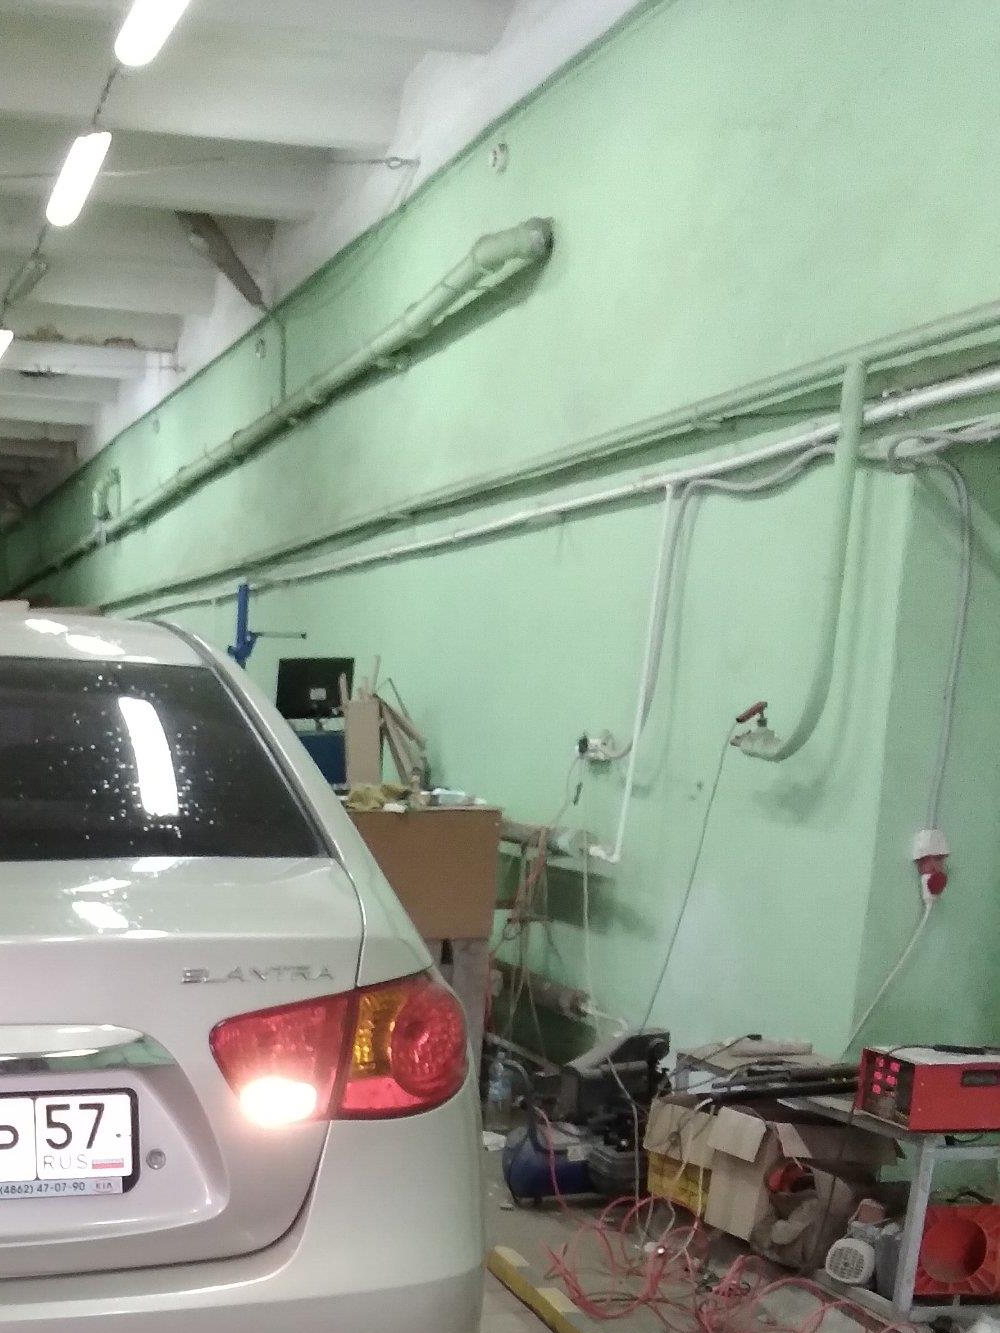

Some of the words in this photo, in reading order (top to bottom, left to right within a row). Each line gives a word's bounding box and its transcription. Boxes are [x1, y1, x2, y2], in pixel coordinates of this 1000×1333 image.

[45, 1102, 105, 1150] 57
[43, 1153, 88, 1170] RUS
[0, 1184, 34, 1196] (4862)
[36, 1181, 86, 1193] 47-07-90
